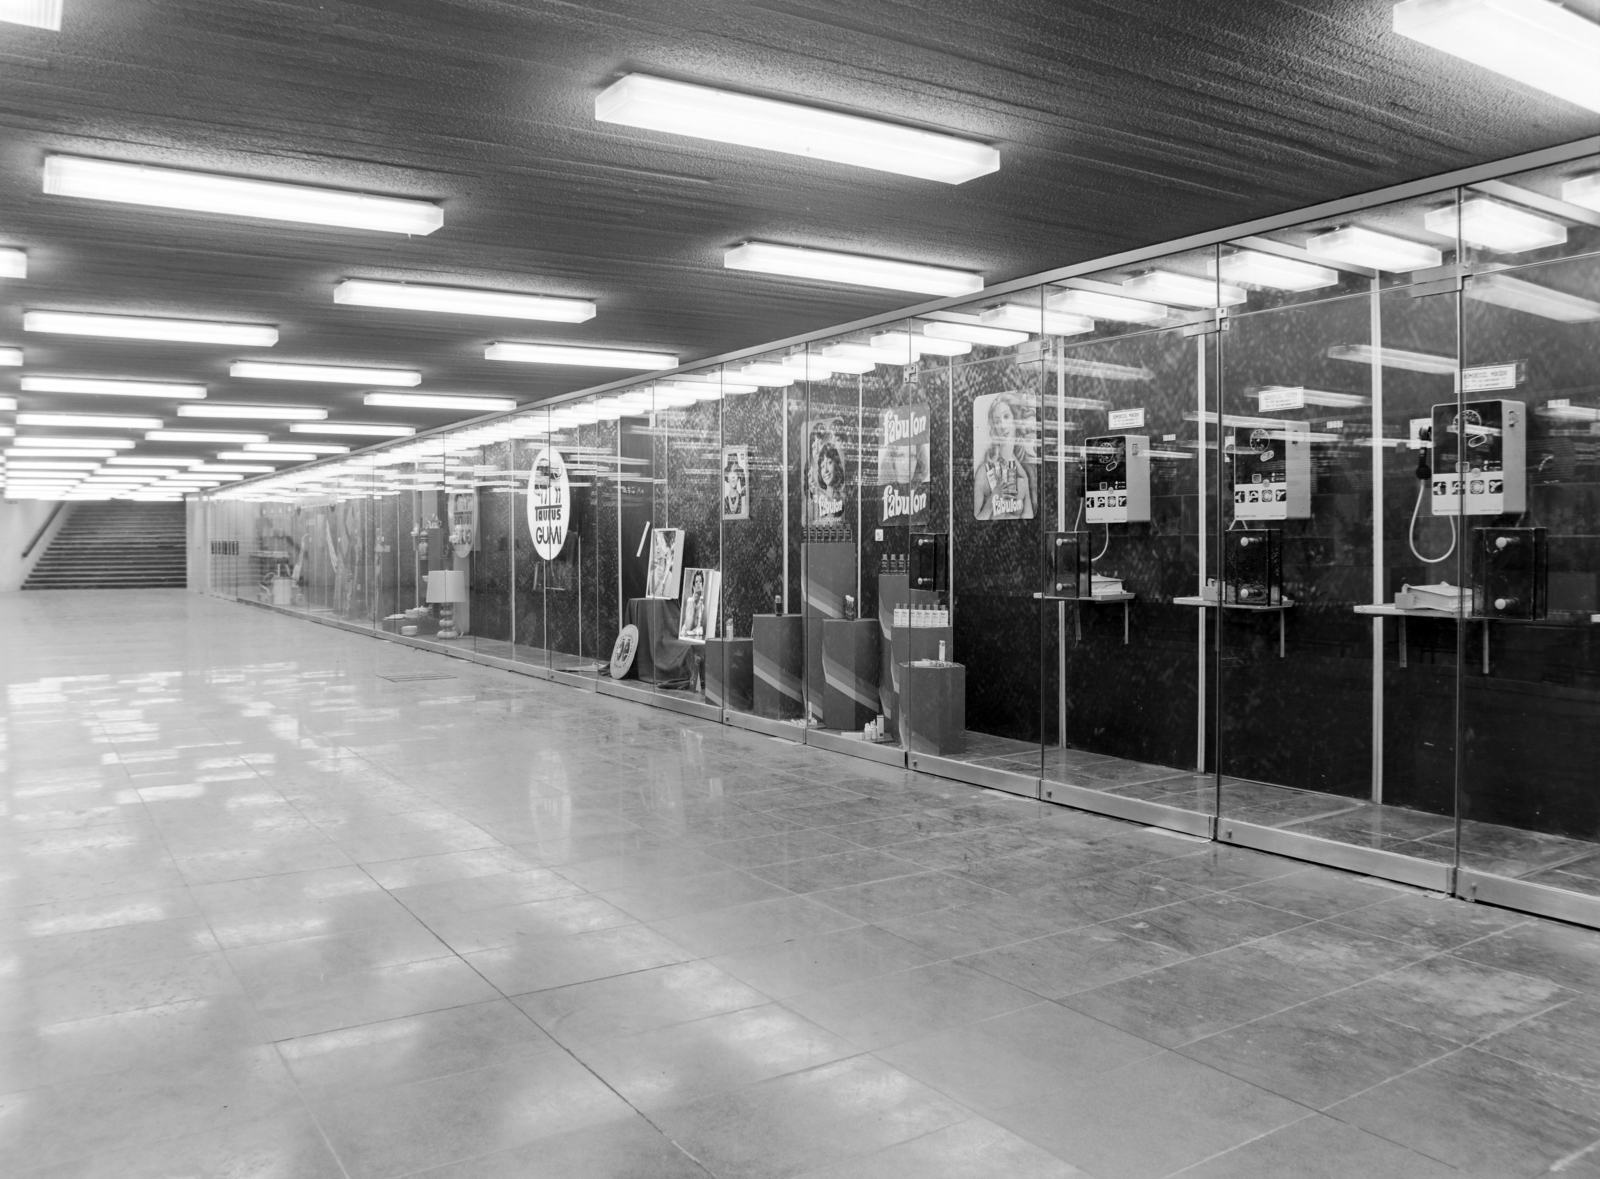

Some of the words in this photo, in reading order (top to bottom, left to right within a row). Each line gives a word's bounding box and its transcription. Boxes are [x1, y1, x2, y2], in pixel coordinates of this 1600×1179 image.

[883, 410, 927, 448] fabulon
[818, 494, 843, 517] fabulon
[882, 484, 927, 523] fabulon
[991, 494, 1022, 517] fabulon
[535, 525, 562, 545] GUMI
